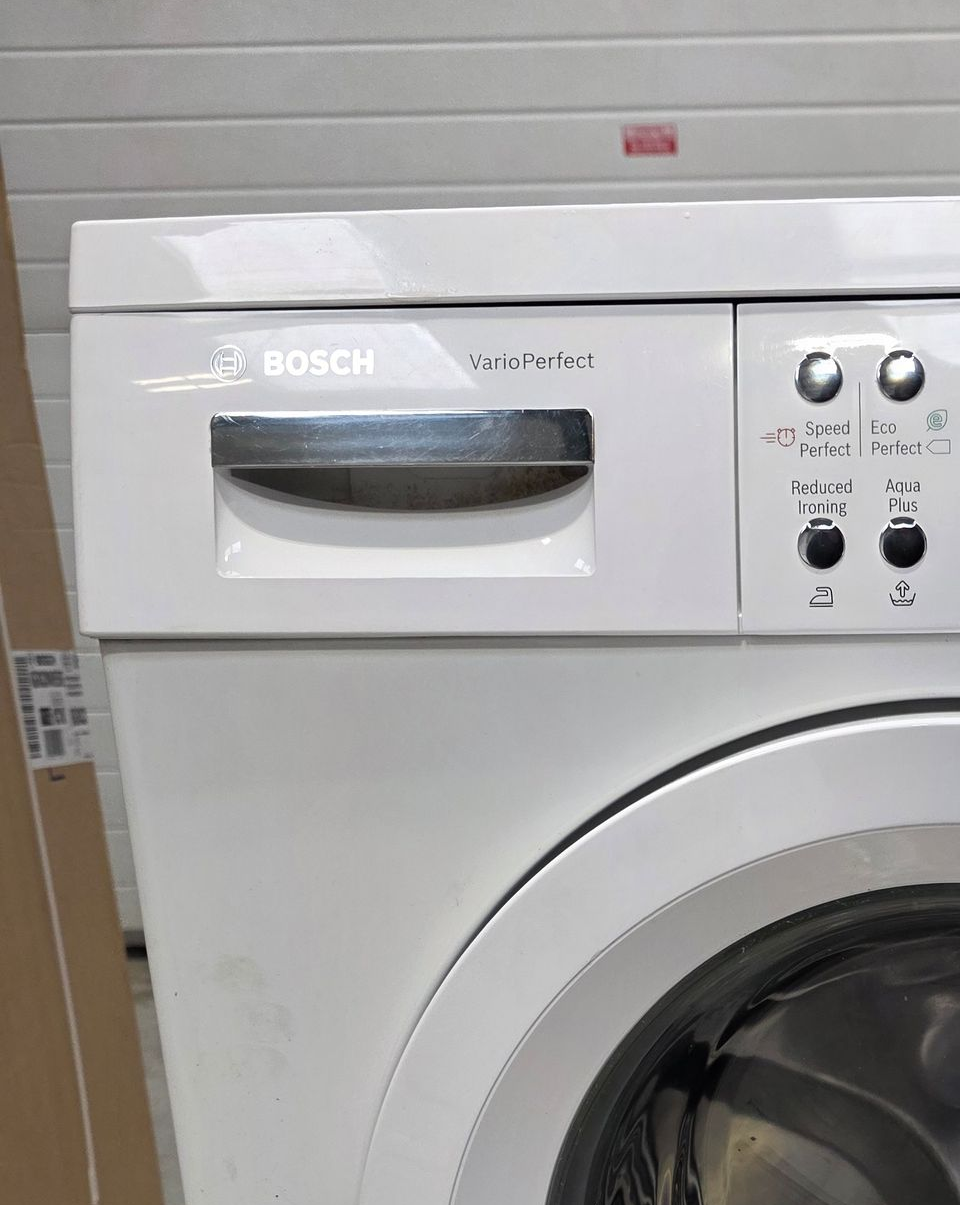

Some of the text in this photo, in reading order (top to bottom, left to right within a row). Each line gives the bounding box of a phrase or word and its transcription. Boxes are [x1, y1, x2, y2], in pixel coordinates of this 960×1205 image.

[263, 350, 375, 376] BOSCH
[470, 352, 594, 370] VarioPerfect
[806, 420, 849, 438] Speed
[872, 420, 896, 434] Eco
[801, 441, 851, 457] Perfect
[872, 440, 922, 455] Perfect
[792, 479, 852, 494] Reduced
[886, 479, 920, 496] Aqua
[799, 500, 847, 518] Ironing
[890, 498, 917, 512] Plus
